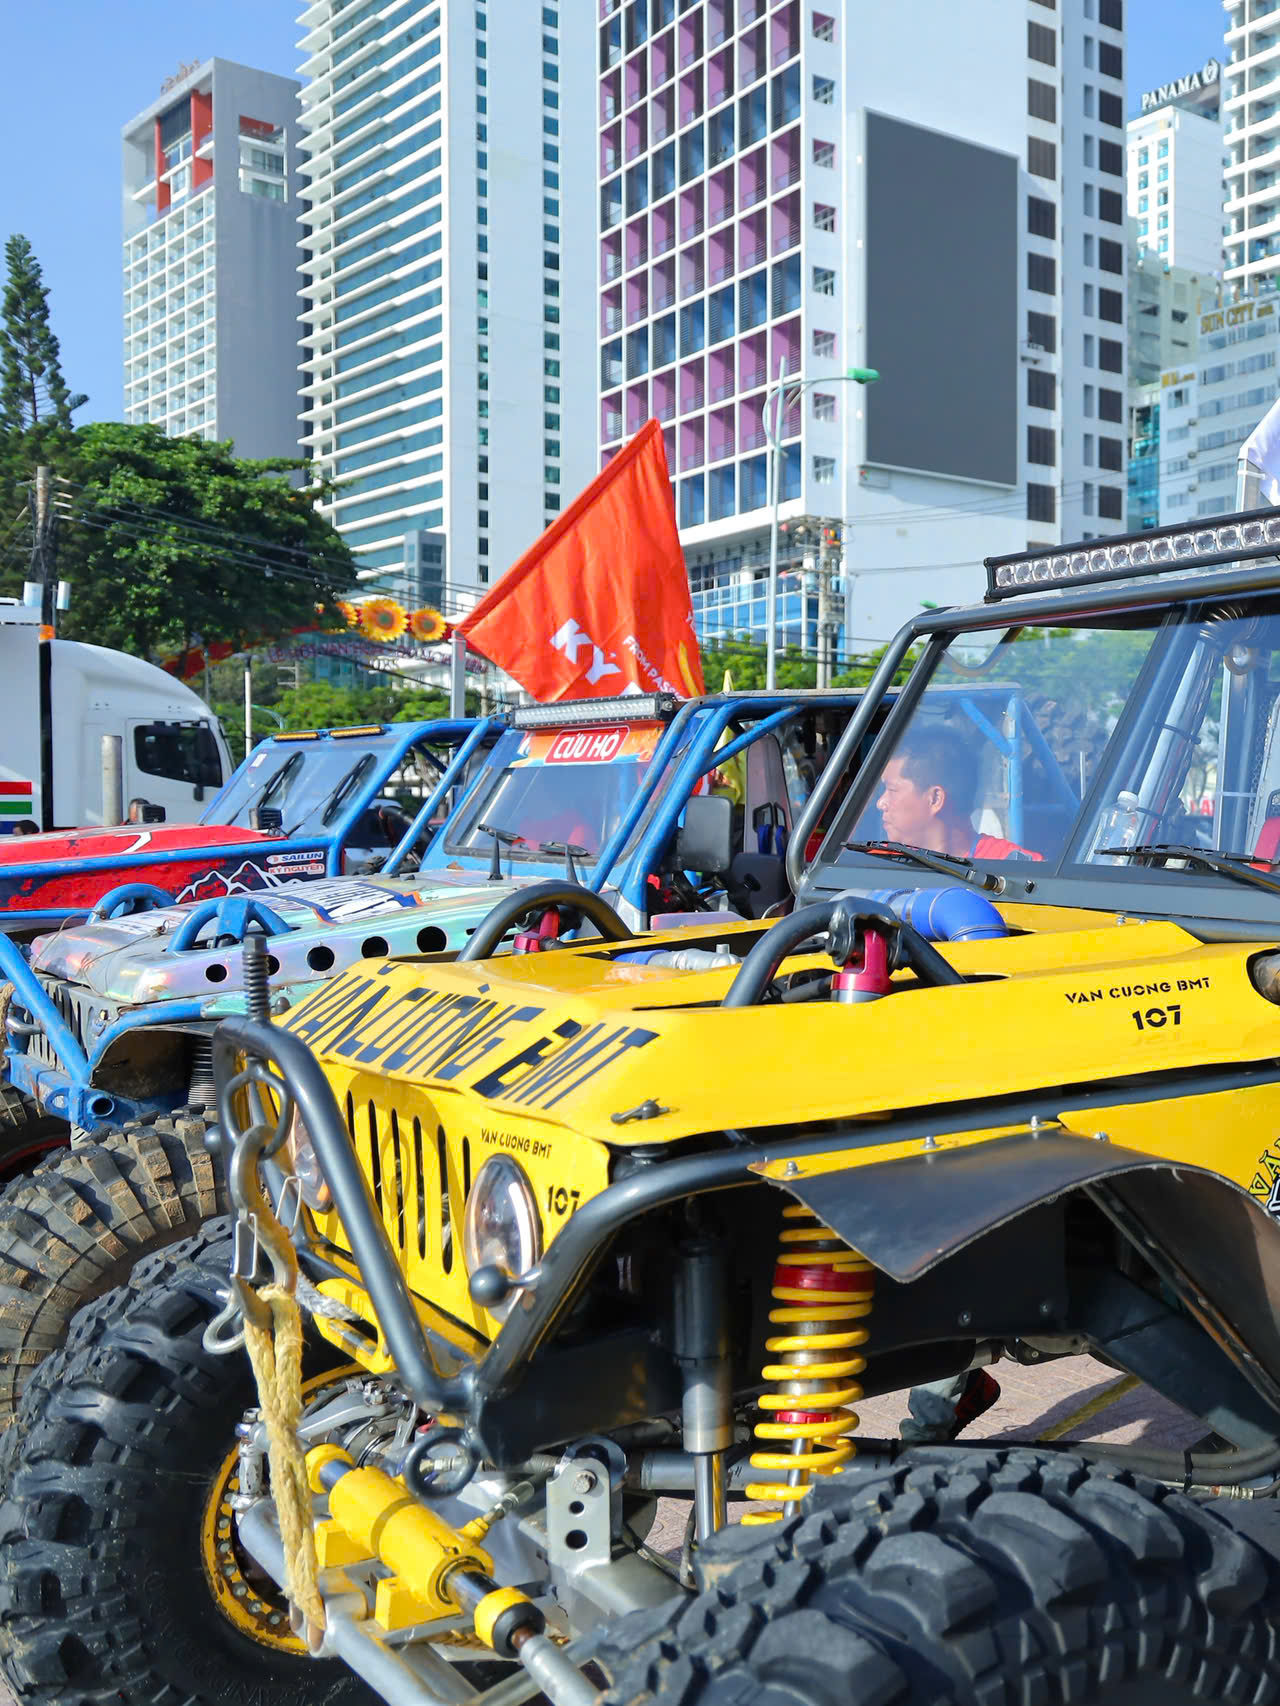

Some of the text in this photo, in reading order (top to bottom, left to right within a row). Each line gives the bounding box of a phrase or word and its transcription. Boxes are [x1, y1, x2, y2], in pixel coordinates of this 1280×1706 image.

[1141, 72, 1201, 111] PANAMA
[1201, 312, 1224, 335] SUN
[1226, 302, 1255, 327] CITY
[622, 635, 651, 672] FROM
[593, 728, 621, 761] HỘ
[281, 852, 322, 862] SAILUN
[1065, 976, 1210, 1004] VAN CUONG BMT
[1132, 1004, 1181, 1031] 107
[481, 1128, 552, 1159] VAN CUONG BMT
[548, 1184, 580, 1216] 107
